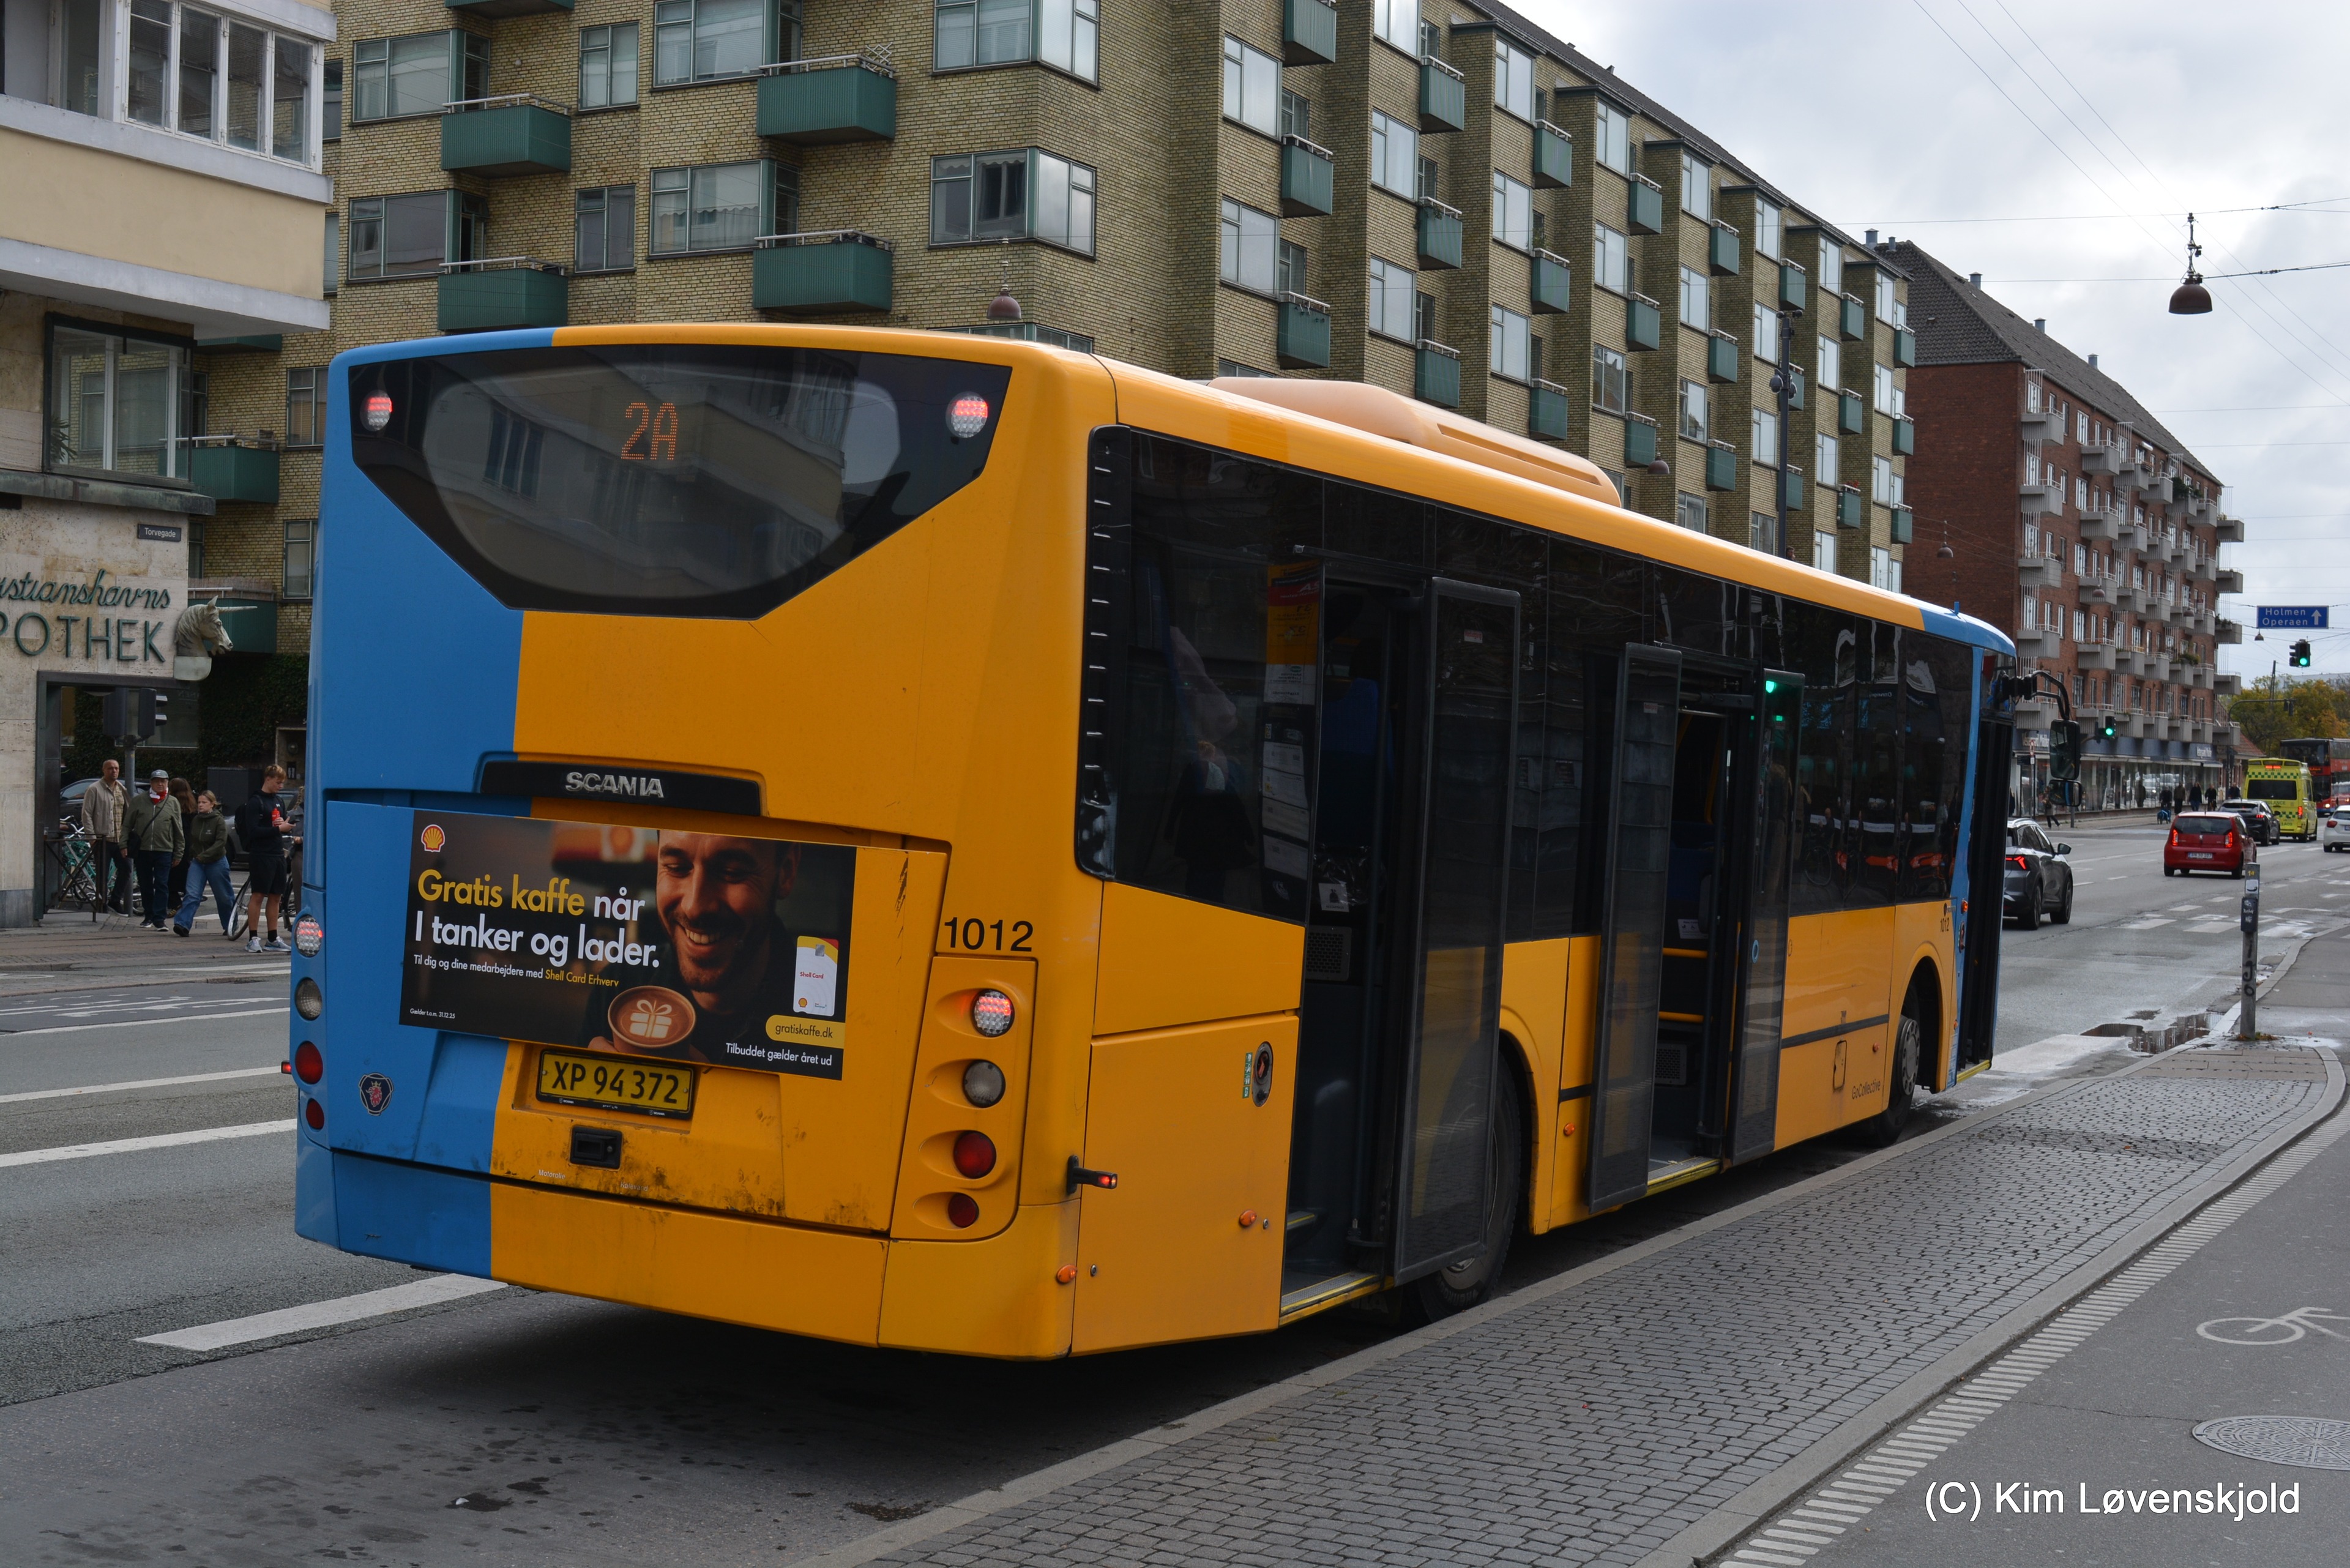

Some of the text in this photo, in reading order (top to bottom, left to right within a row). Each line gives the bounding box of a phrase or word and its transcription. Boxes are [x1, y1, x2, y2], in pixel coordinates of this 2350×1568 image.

[621, 401, 678, 460] 2A
[144, 528, 176, 539] Torvegade
[2262, 617, 2308, 627] Operaen
[565, 772, 664, 798] SCANIA
[418, 869, 645, 921] Gratis kaffe når
[944, 917, 1034, 952] 1012
[1940, 917, 1950, 933] 1012
[415, 910, 660, 968] I tanker og lader.
[414, 954, 619, 987] Til dig og dine medarbejdere med Shell Card Erhverv
[775, 1024, 833, 1038] gratiskaffe.dk
[726, 1042, 832, 1066] Tilbuddet gælder året ud
[552, 1061, 586, 1091] XP
[1851, 1078, 1881, 1100] GoCollective
[539, 1169, 565, 1179] Motorolie
[621, 1182, 649, 1192] Kølevand
